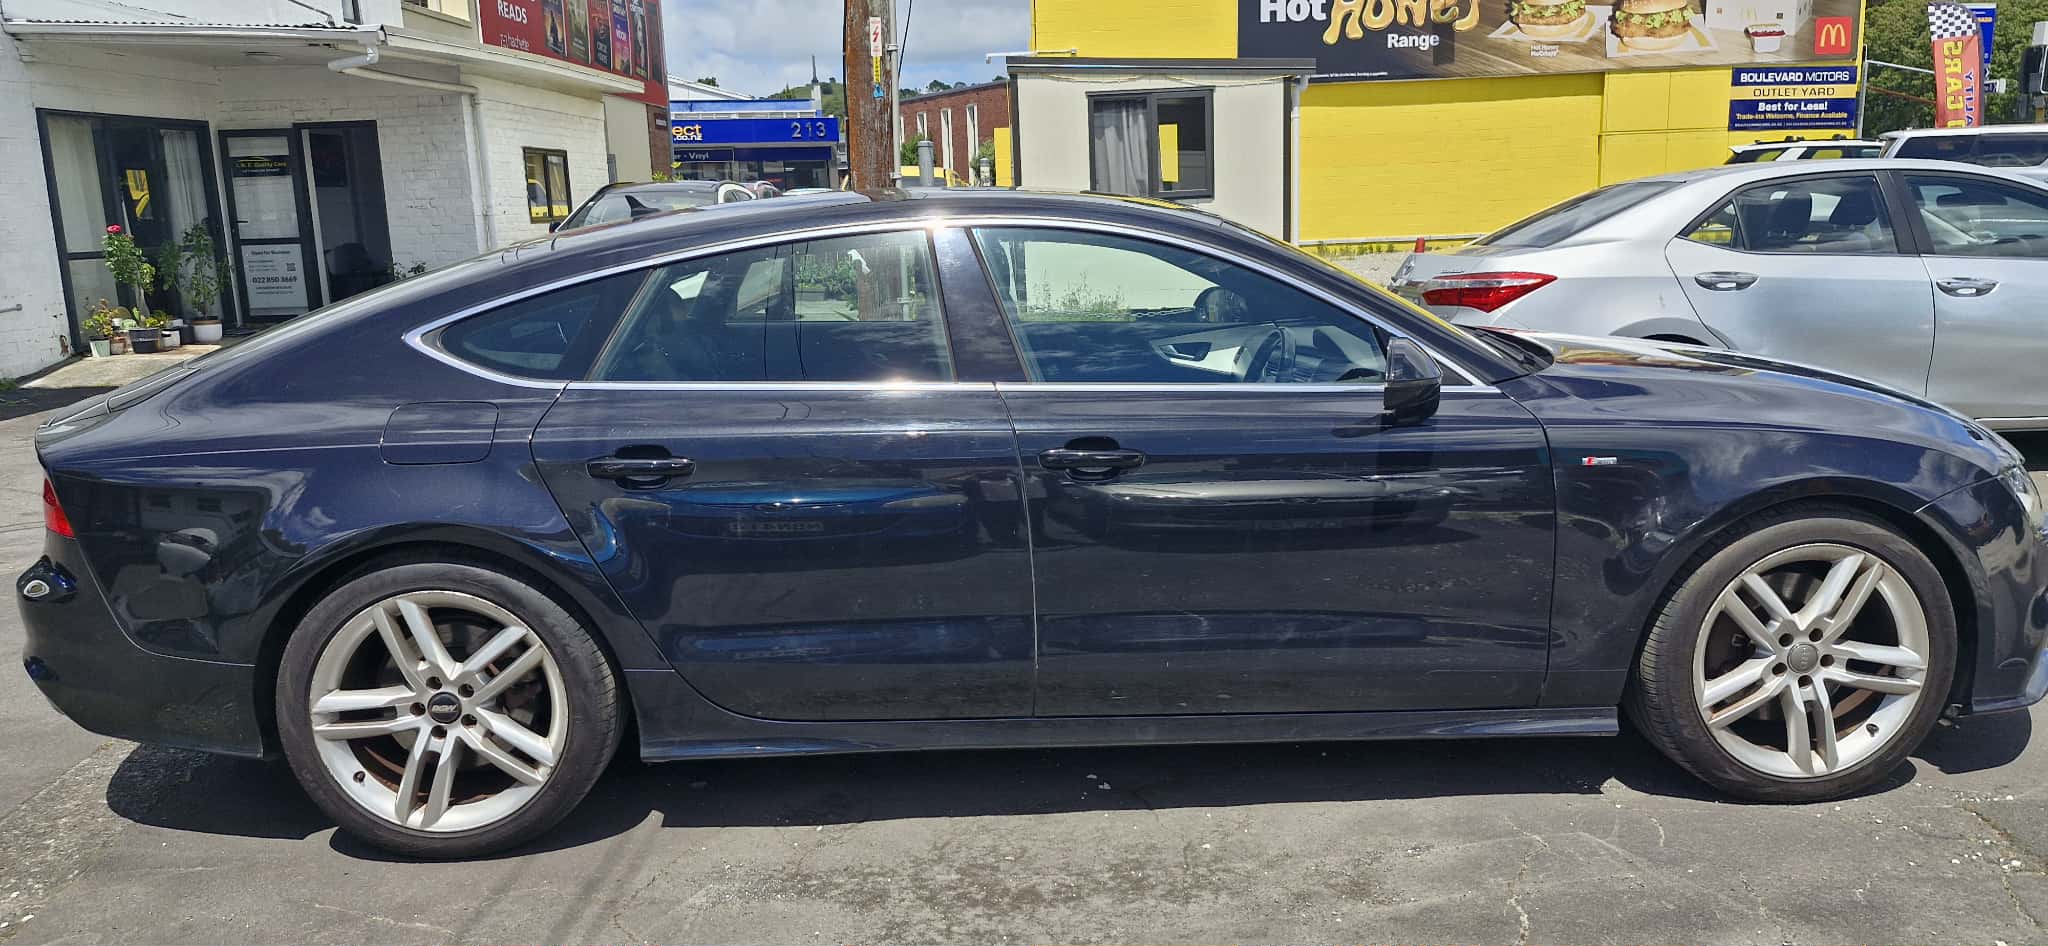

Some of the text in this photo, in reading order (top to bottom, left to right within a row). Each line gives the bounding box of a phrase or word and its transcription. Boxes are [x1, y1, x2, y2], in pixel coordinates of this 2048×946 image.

[497, 0, 528, 24] READS
[1260, 0, 1327, 23] Hot
[1387, 33, 1440, 50] Range
[1740, 71, 1850, 83] BOULEVARD MOTORS
[1753, 87, 1835, 97] OUTLET YARD
[1758, 101, 1828, 111] Best for Less!
[790, 121, 826, 138] 213
